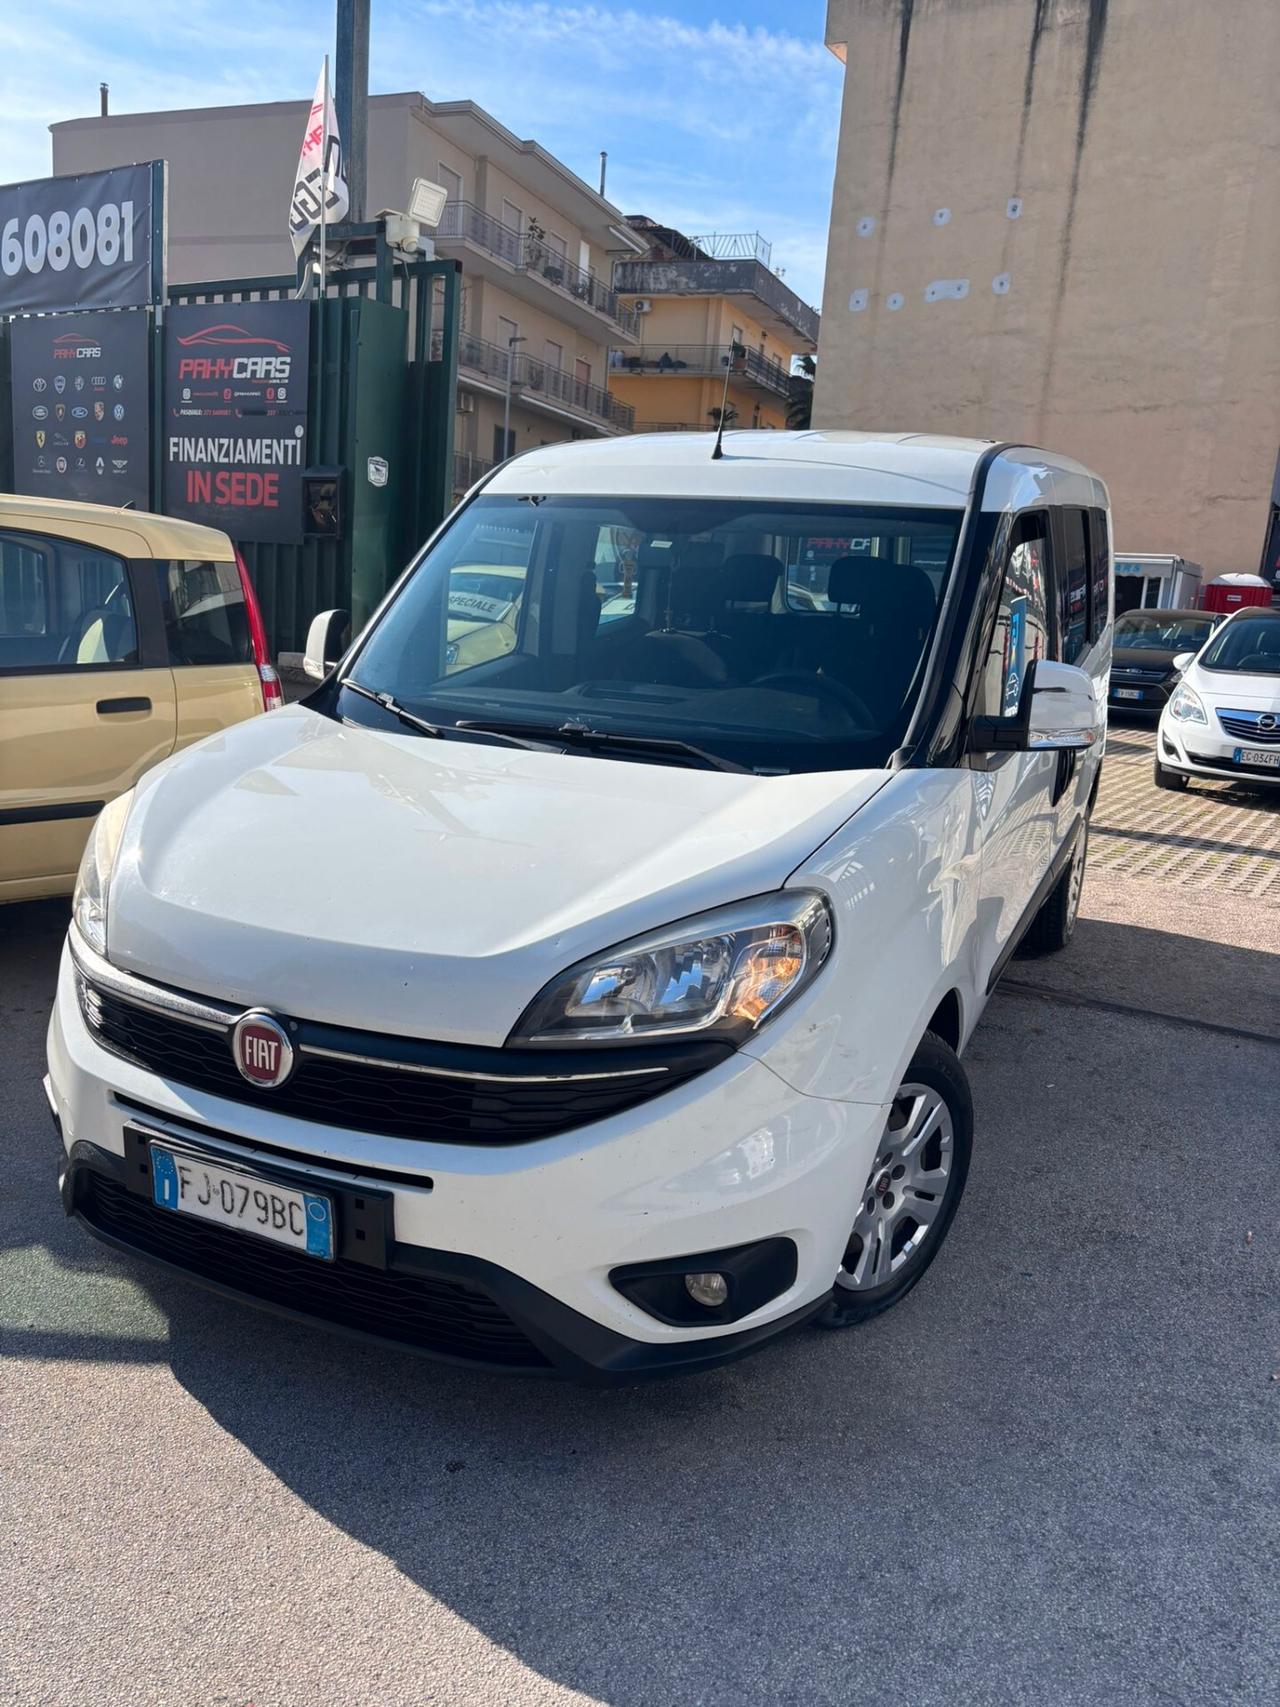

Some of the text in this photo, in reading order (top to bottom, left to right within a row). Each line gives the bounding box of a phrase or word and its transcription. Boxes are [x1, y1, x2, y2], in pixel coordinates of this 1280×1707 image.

[1, 201, 133, 276] 608081
[169, 434, 302, 465] FINANZIAMENTI
[187, 470, 279, 507] IN SEDE
[245, 1035, 278, 1071] FIAT
